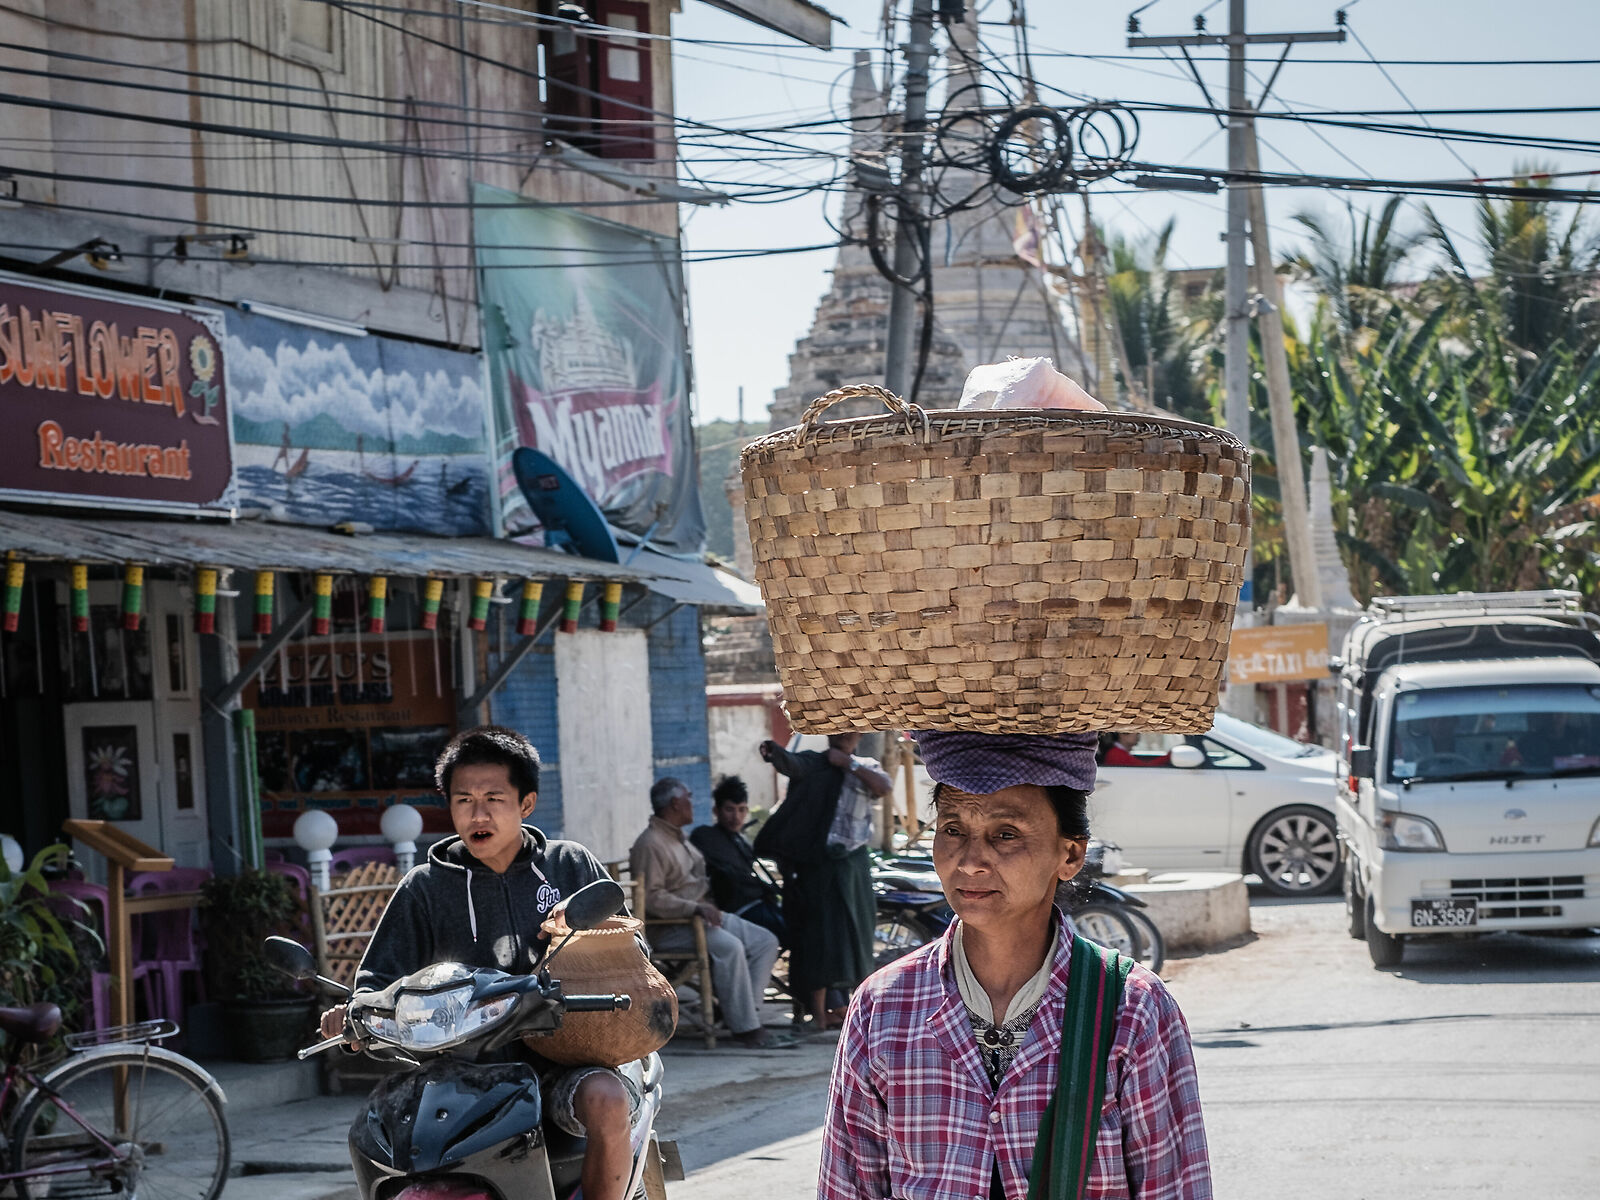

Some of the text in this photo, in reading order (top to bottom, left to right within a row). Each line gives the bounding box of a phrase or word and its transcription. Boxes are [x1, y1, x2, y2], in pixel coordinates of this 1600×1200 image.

[0, 303, 186, 418] SUNFLOWER
[37, 420, 192, 480] Restaurant
[256, 652, 392, 682] ZUZU'S
[1265, 653, 1303, 676] TAXI
[1489, 834, 1546, 845] HIJET
